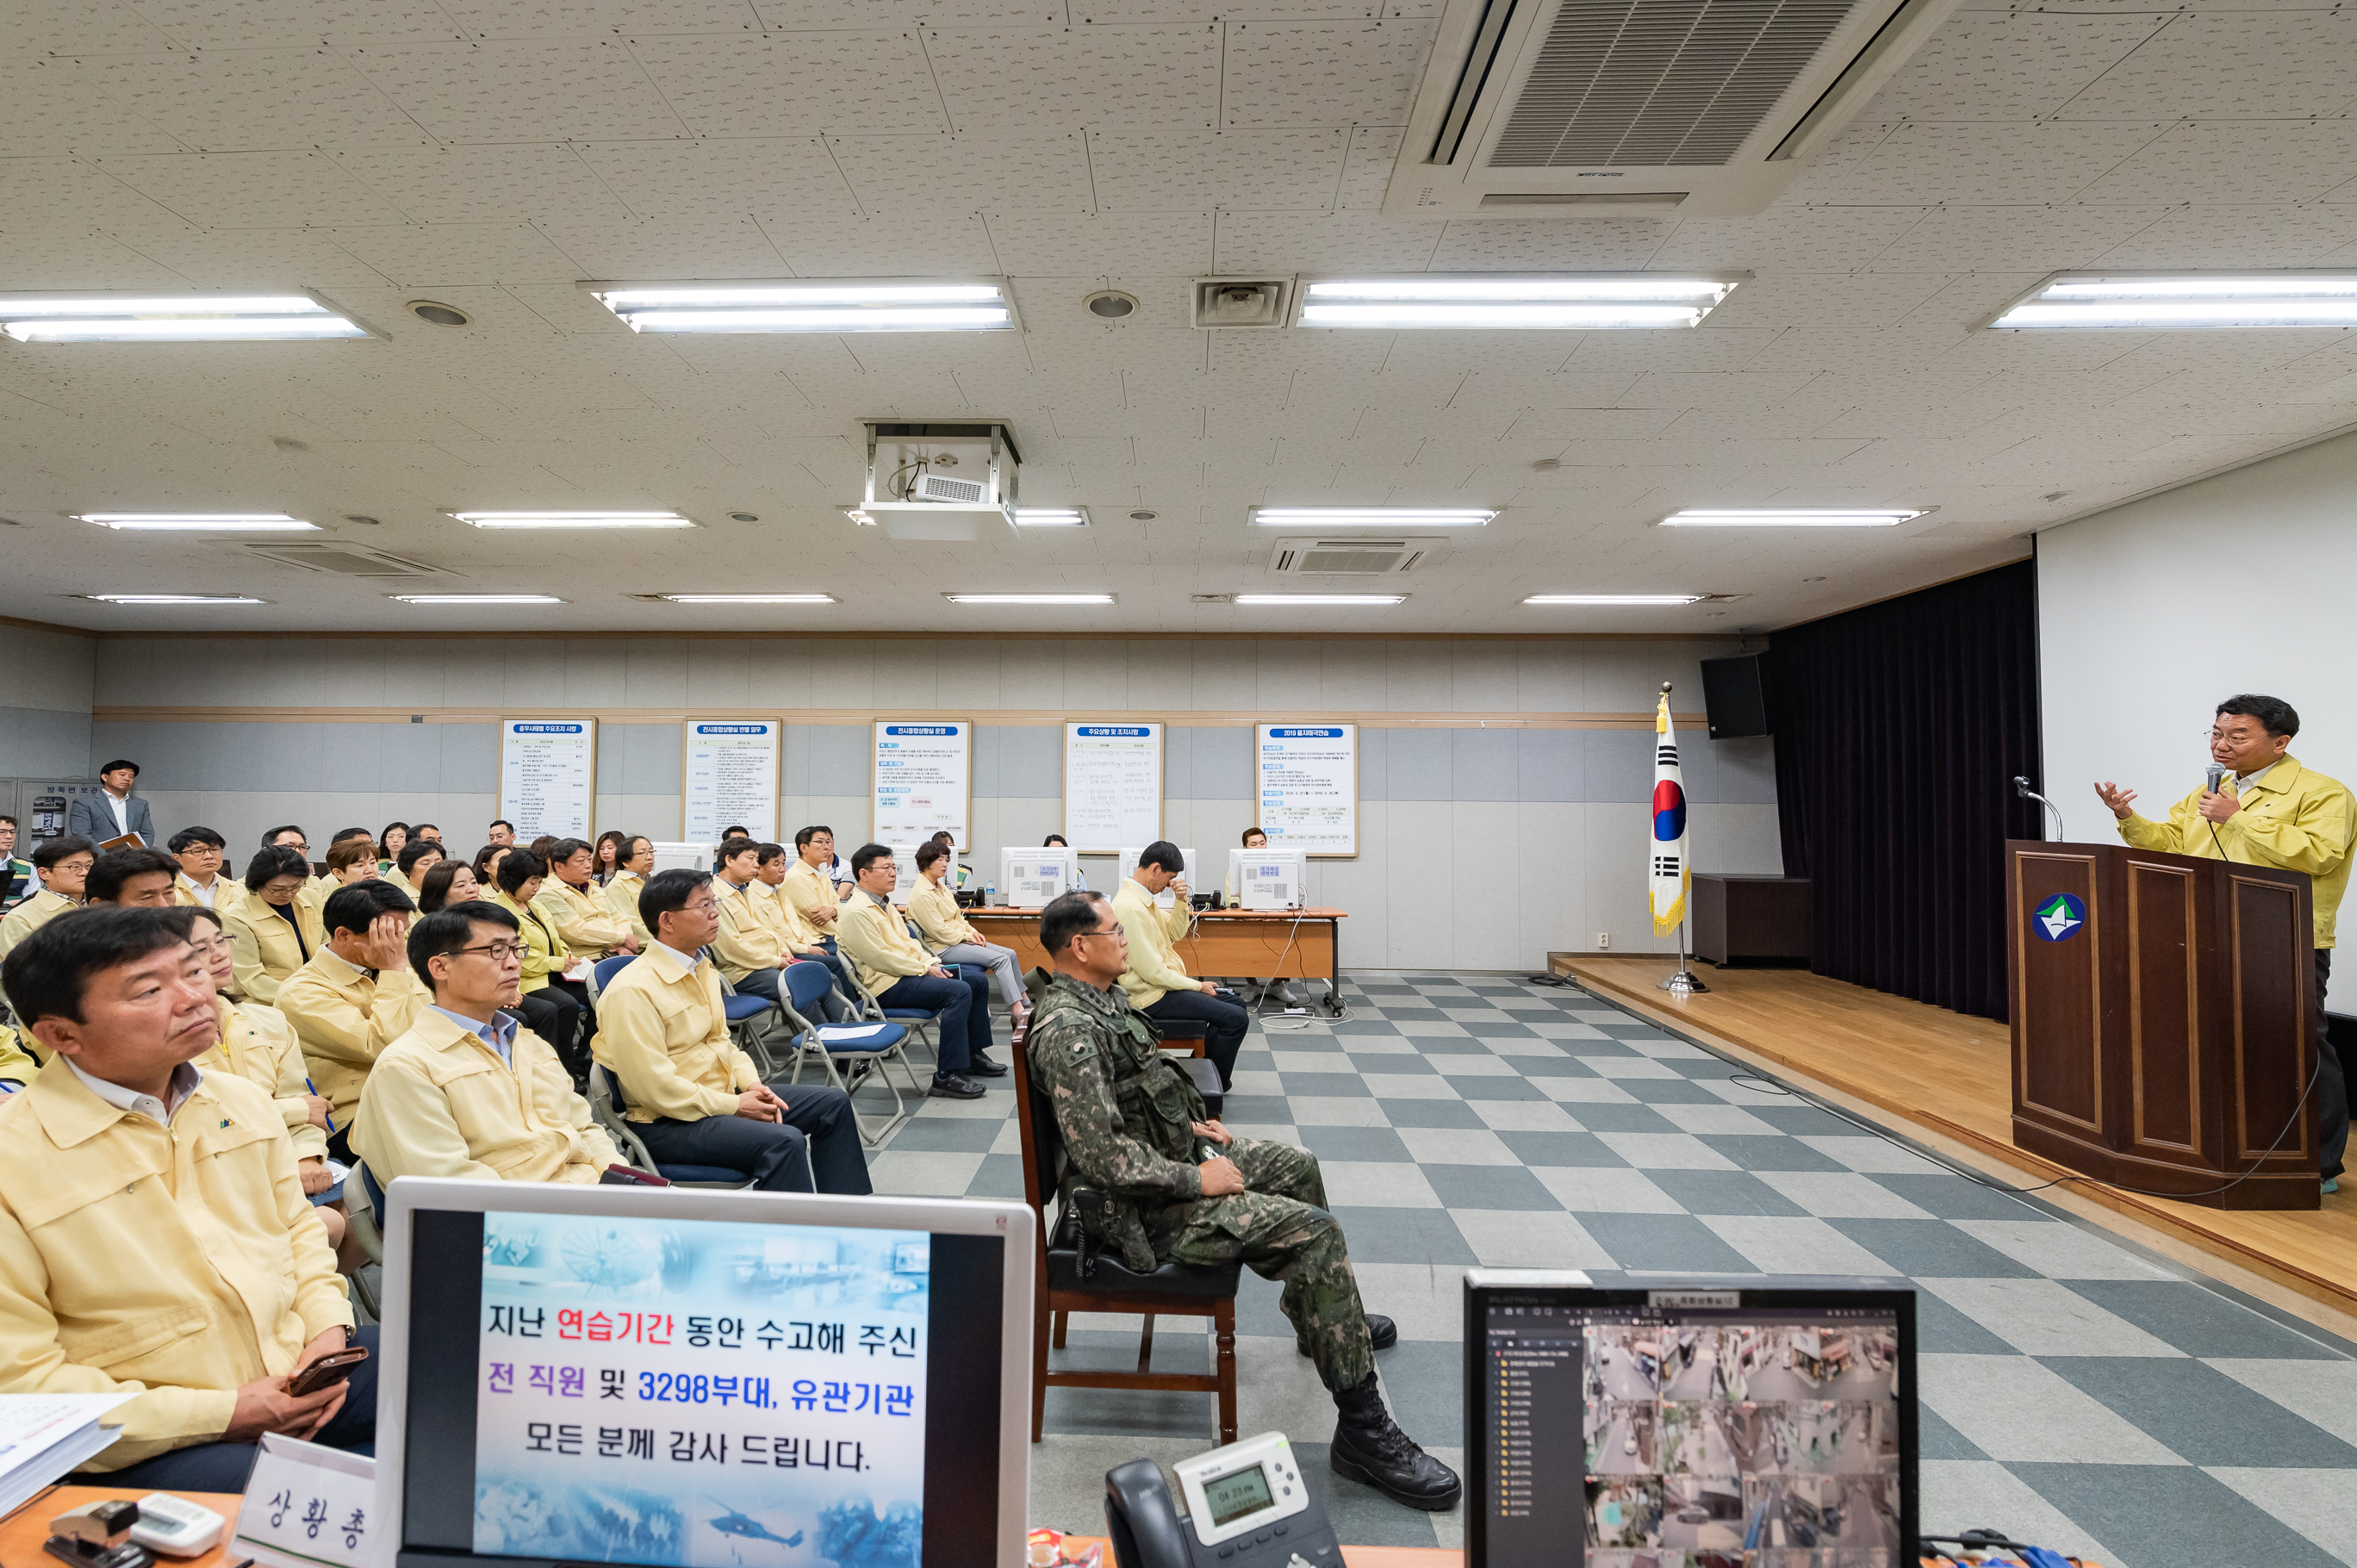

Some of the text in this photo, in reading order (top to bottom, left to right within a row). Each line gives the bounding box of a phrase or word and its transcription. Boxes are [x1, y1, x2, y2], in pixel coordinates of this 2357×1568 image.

[487, 1304, 917, 1359] 지난 연습기간 동안 수고해 주신
[488, 1362, 914, 1417] 전 직원 및 3298부대, 유관기관
[526, 1422, 871, 1472] 모든 분께 감사 드립니다.
